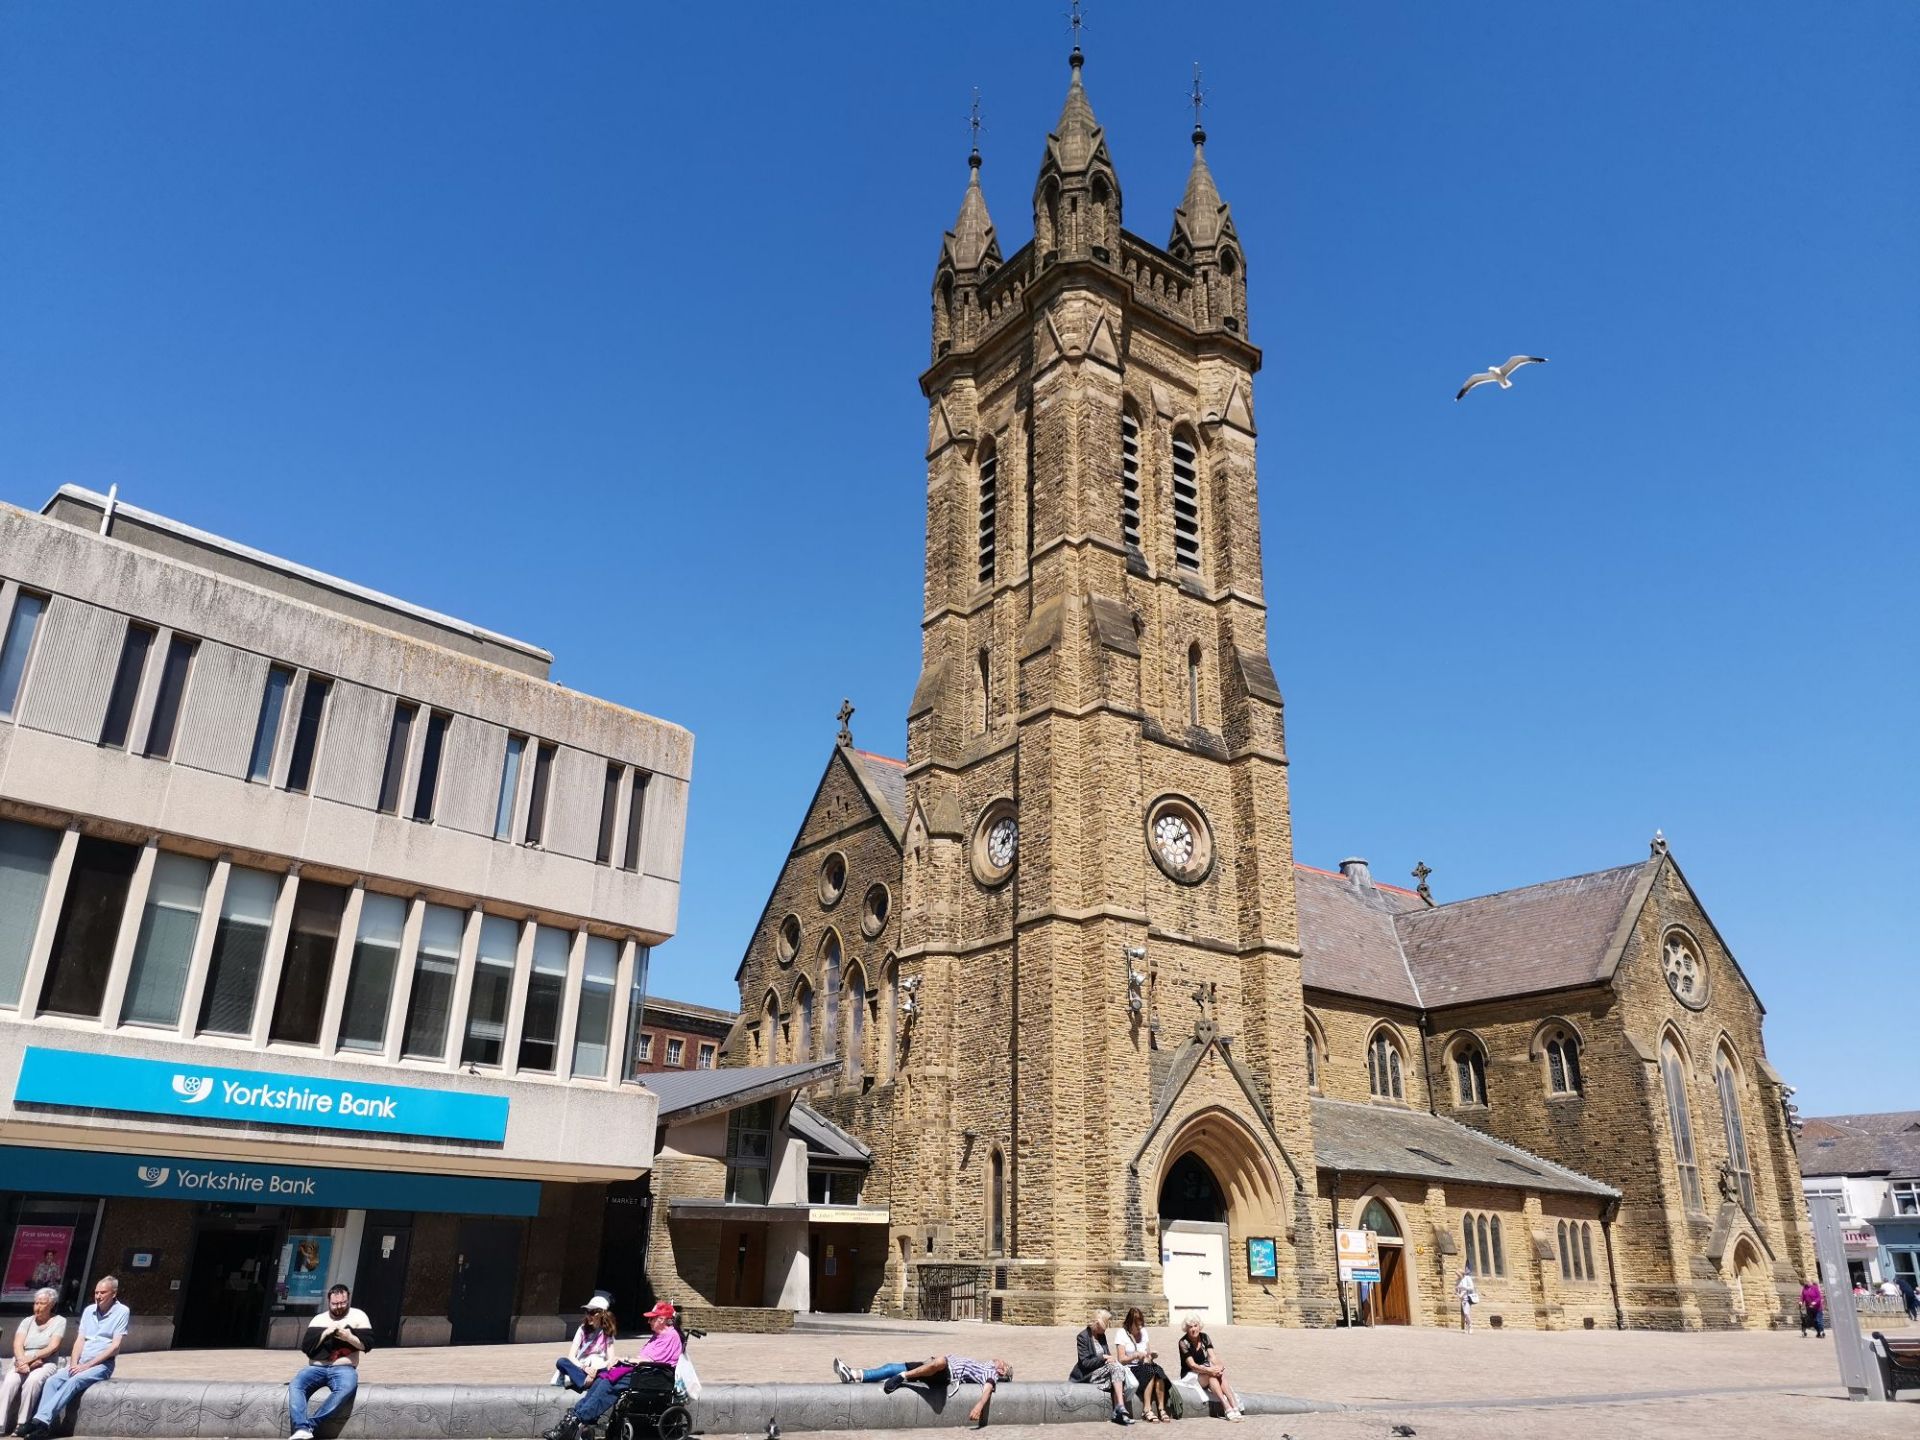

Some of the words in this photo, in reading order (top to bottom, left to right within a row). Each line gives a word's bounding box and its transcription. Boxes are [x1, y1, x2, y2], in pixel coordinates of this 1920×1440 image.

[222, 1080, 332, 1112] Yorkshire
[338, 1092, 398, 1118] Bank
[176, 1169, 264, 1192] Yorkshire
[269, 1175, 316, 1194] Bank
[611, 1197, 639, 1205] MARKET
